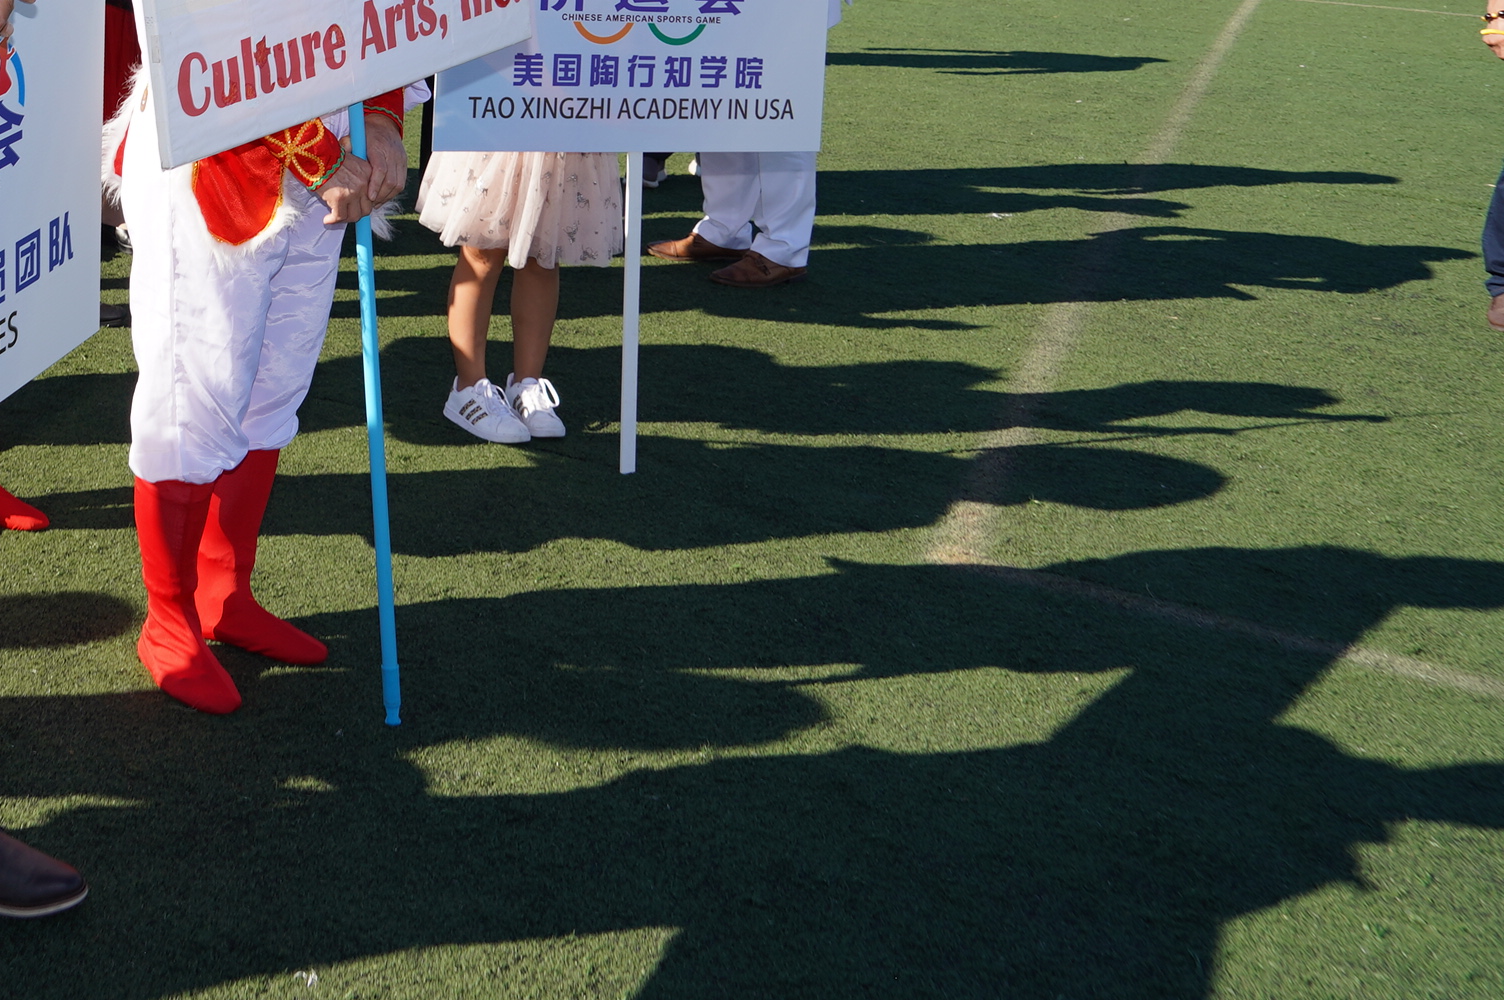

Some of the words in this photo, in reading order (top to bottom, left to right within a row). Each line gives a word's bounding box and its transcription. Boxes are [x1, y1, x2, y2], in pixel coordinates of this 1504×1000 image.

[561, 13, 603, 23] CHINESE
[605, 14, 654, 23] AMERICAN
[657, 15, 693, 24] SPORTS
[696, 15, 721, 25] GAME
[177, 23, 346, 117] Culture
[513, 52, 764, 89] 美国陶行知学院
[468, 97, 515, 119] TAO
[521, 97, 612, 119] XINGZHI
[617, 98, 724, 120] ACADEMY
[728, 98, 748, 120] IN
[754, 99, 794, 120] USA
